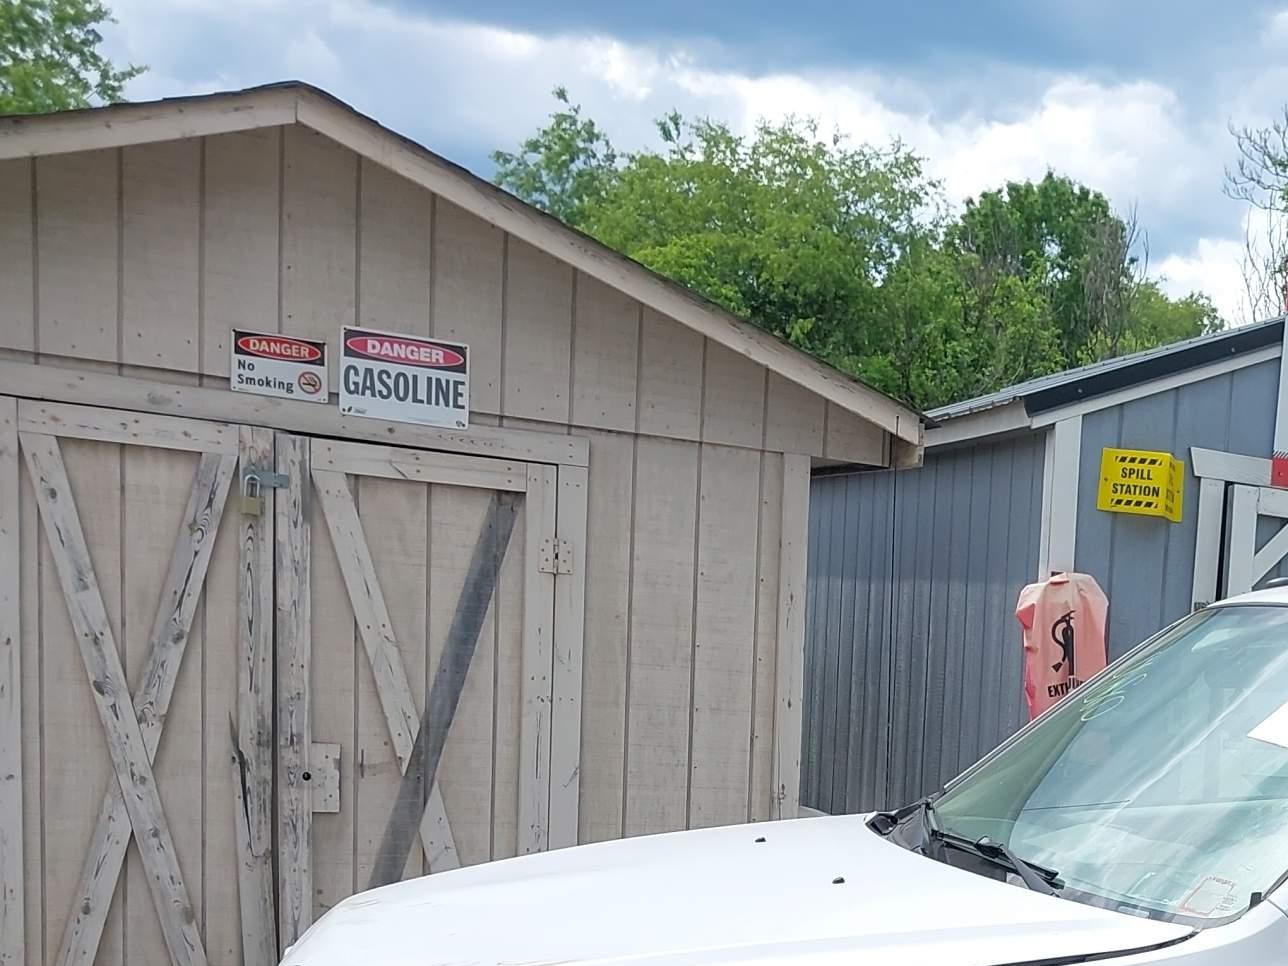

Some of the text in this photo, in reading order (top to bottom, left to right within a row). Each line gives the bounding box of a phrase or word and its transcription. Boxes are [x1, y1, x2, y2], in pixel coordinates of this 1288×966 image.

[249, 339, 310, 358] DANGER
[367, 339, 444, 363] DANGER
[237, 359, 255, 371] No
[237, 373, 294, 394] Smoking
[344, 364, 466, 409] GASOLINE
[1121, 467, 1152, 480] SPILL
[1112, 483, 1160, 497] STATION
